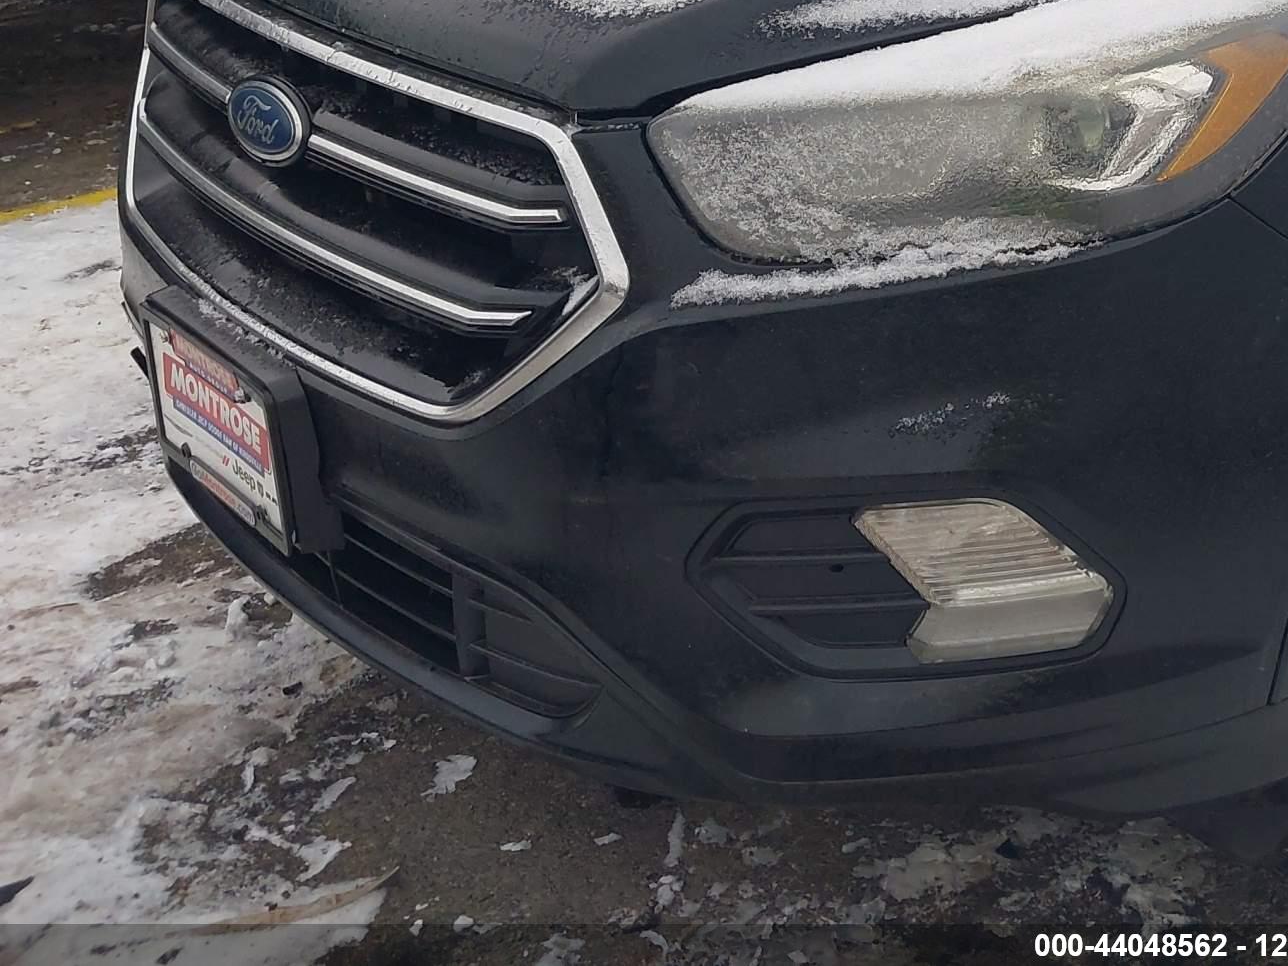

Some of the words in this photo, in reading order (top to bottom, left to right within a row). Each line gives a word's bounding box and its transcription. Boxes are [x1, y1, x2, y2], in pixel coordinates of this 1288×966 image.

[237, 95, 279, 144] Ford
[170, 362, 262, 453] MONTROSE
[232, 459, 256, 492] Jeep
